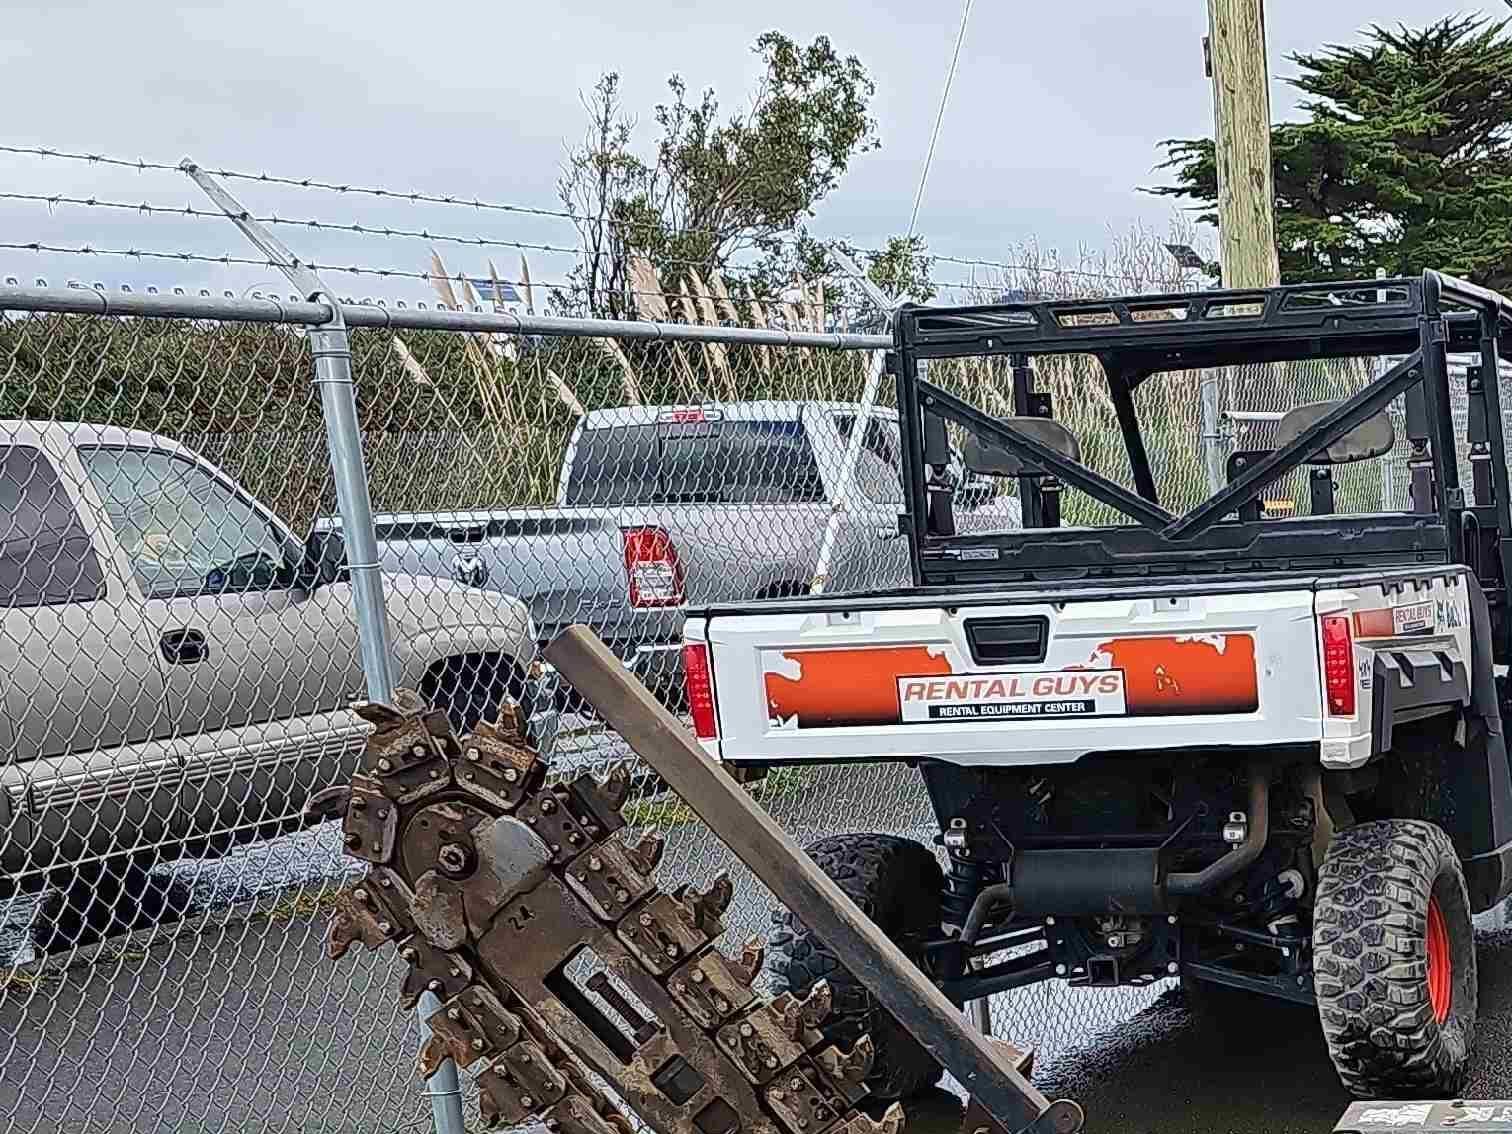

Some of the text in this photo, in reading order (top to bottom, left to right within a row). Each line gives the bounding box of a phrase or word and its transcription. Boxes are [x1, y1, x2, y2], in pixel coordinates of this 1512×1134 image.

[903, 674, 1120, 702] RENTAL GUYS
[939, 701, 1086, 717] RENTAL EQUIPMENT CENTER
